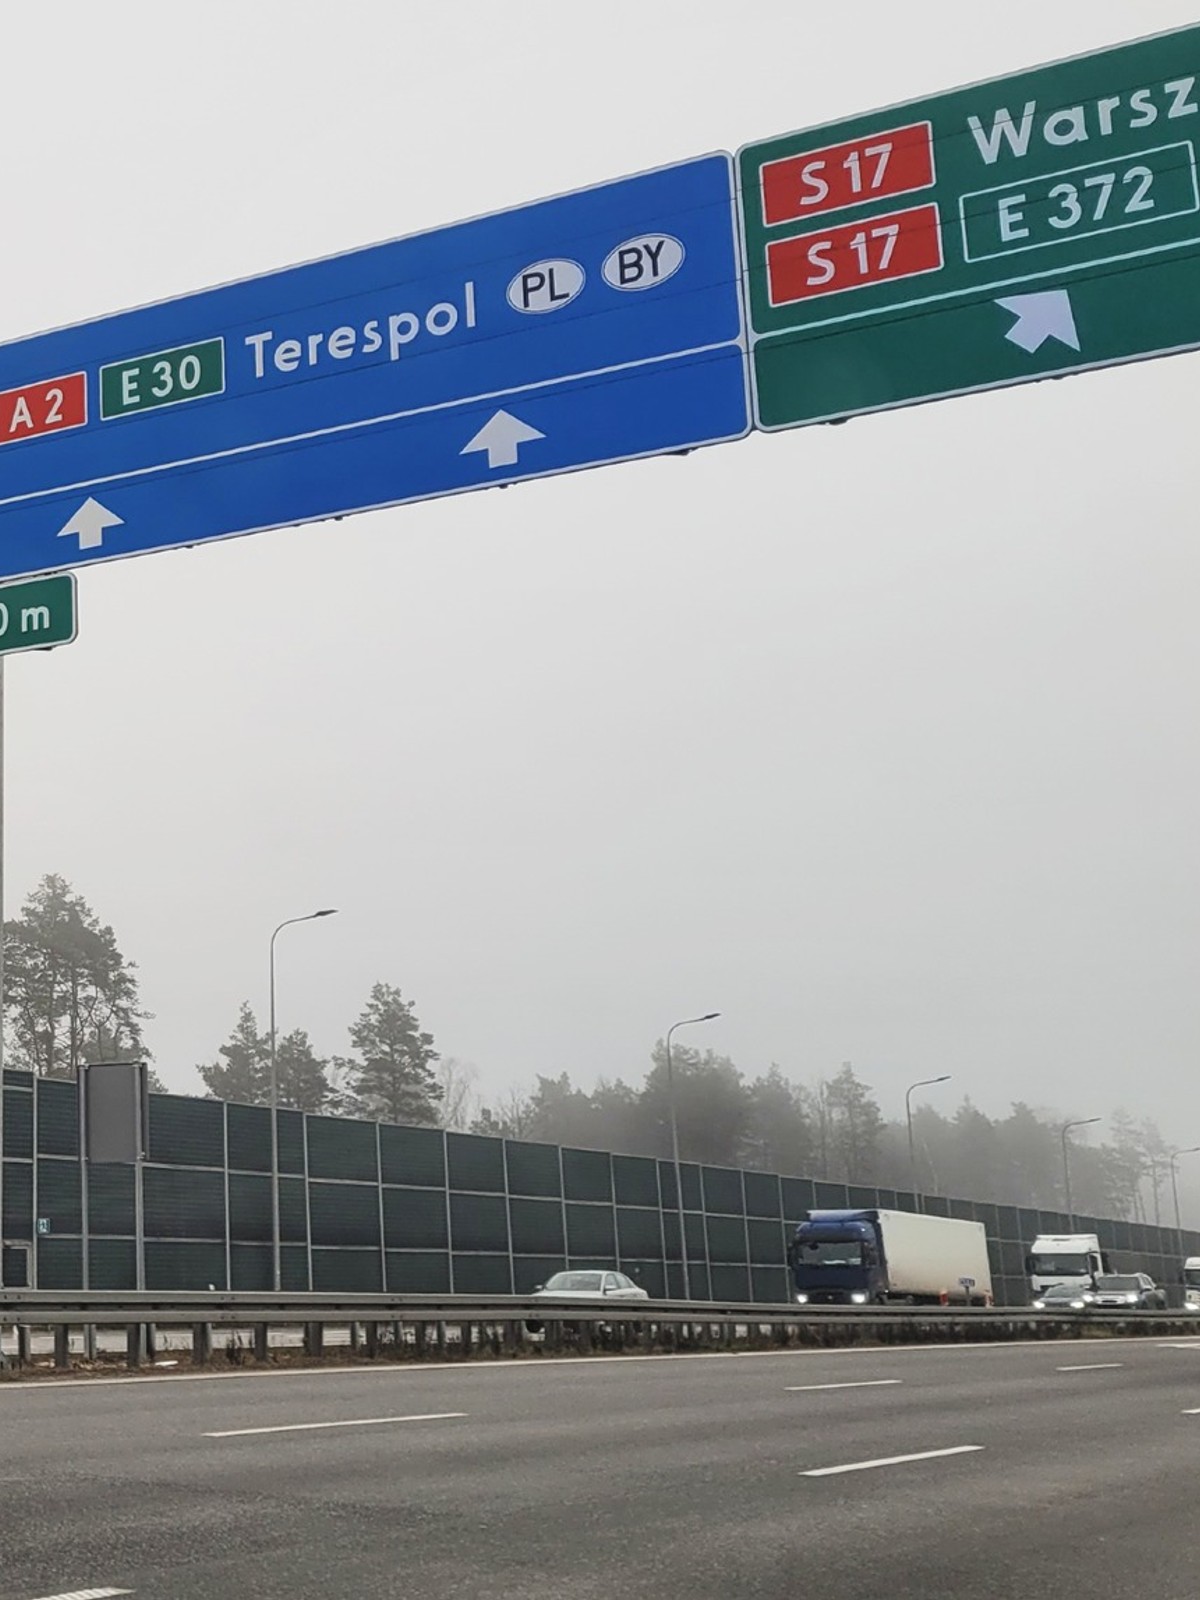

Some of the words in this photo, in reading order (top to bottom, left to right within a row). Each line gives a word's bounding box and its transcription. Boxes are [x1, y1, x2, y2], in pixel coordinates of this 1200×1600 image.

[967, 76, 1198, 165] Warsz
[799, 161, 829, 205] S
[843, 142, 893, 193] 17
[999, 194, 1029, 242] E
[1047, 166, 1155, 229] 372
[617, 240, 666, 285] BY
[806, 241, 836, 286] S
[849, 224, 899, 274] 17
[521, 268, 570, 308] PL
[245, 281, 477, 378] Terespol
[122, 367, 140, 406] E
[151, 355, 201, 397] 30
[9, 396, 35, 433] A
[44, 388, 64, 424] 2
[21, 605, 50, 632] m
